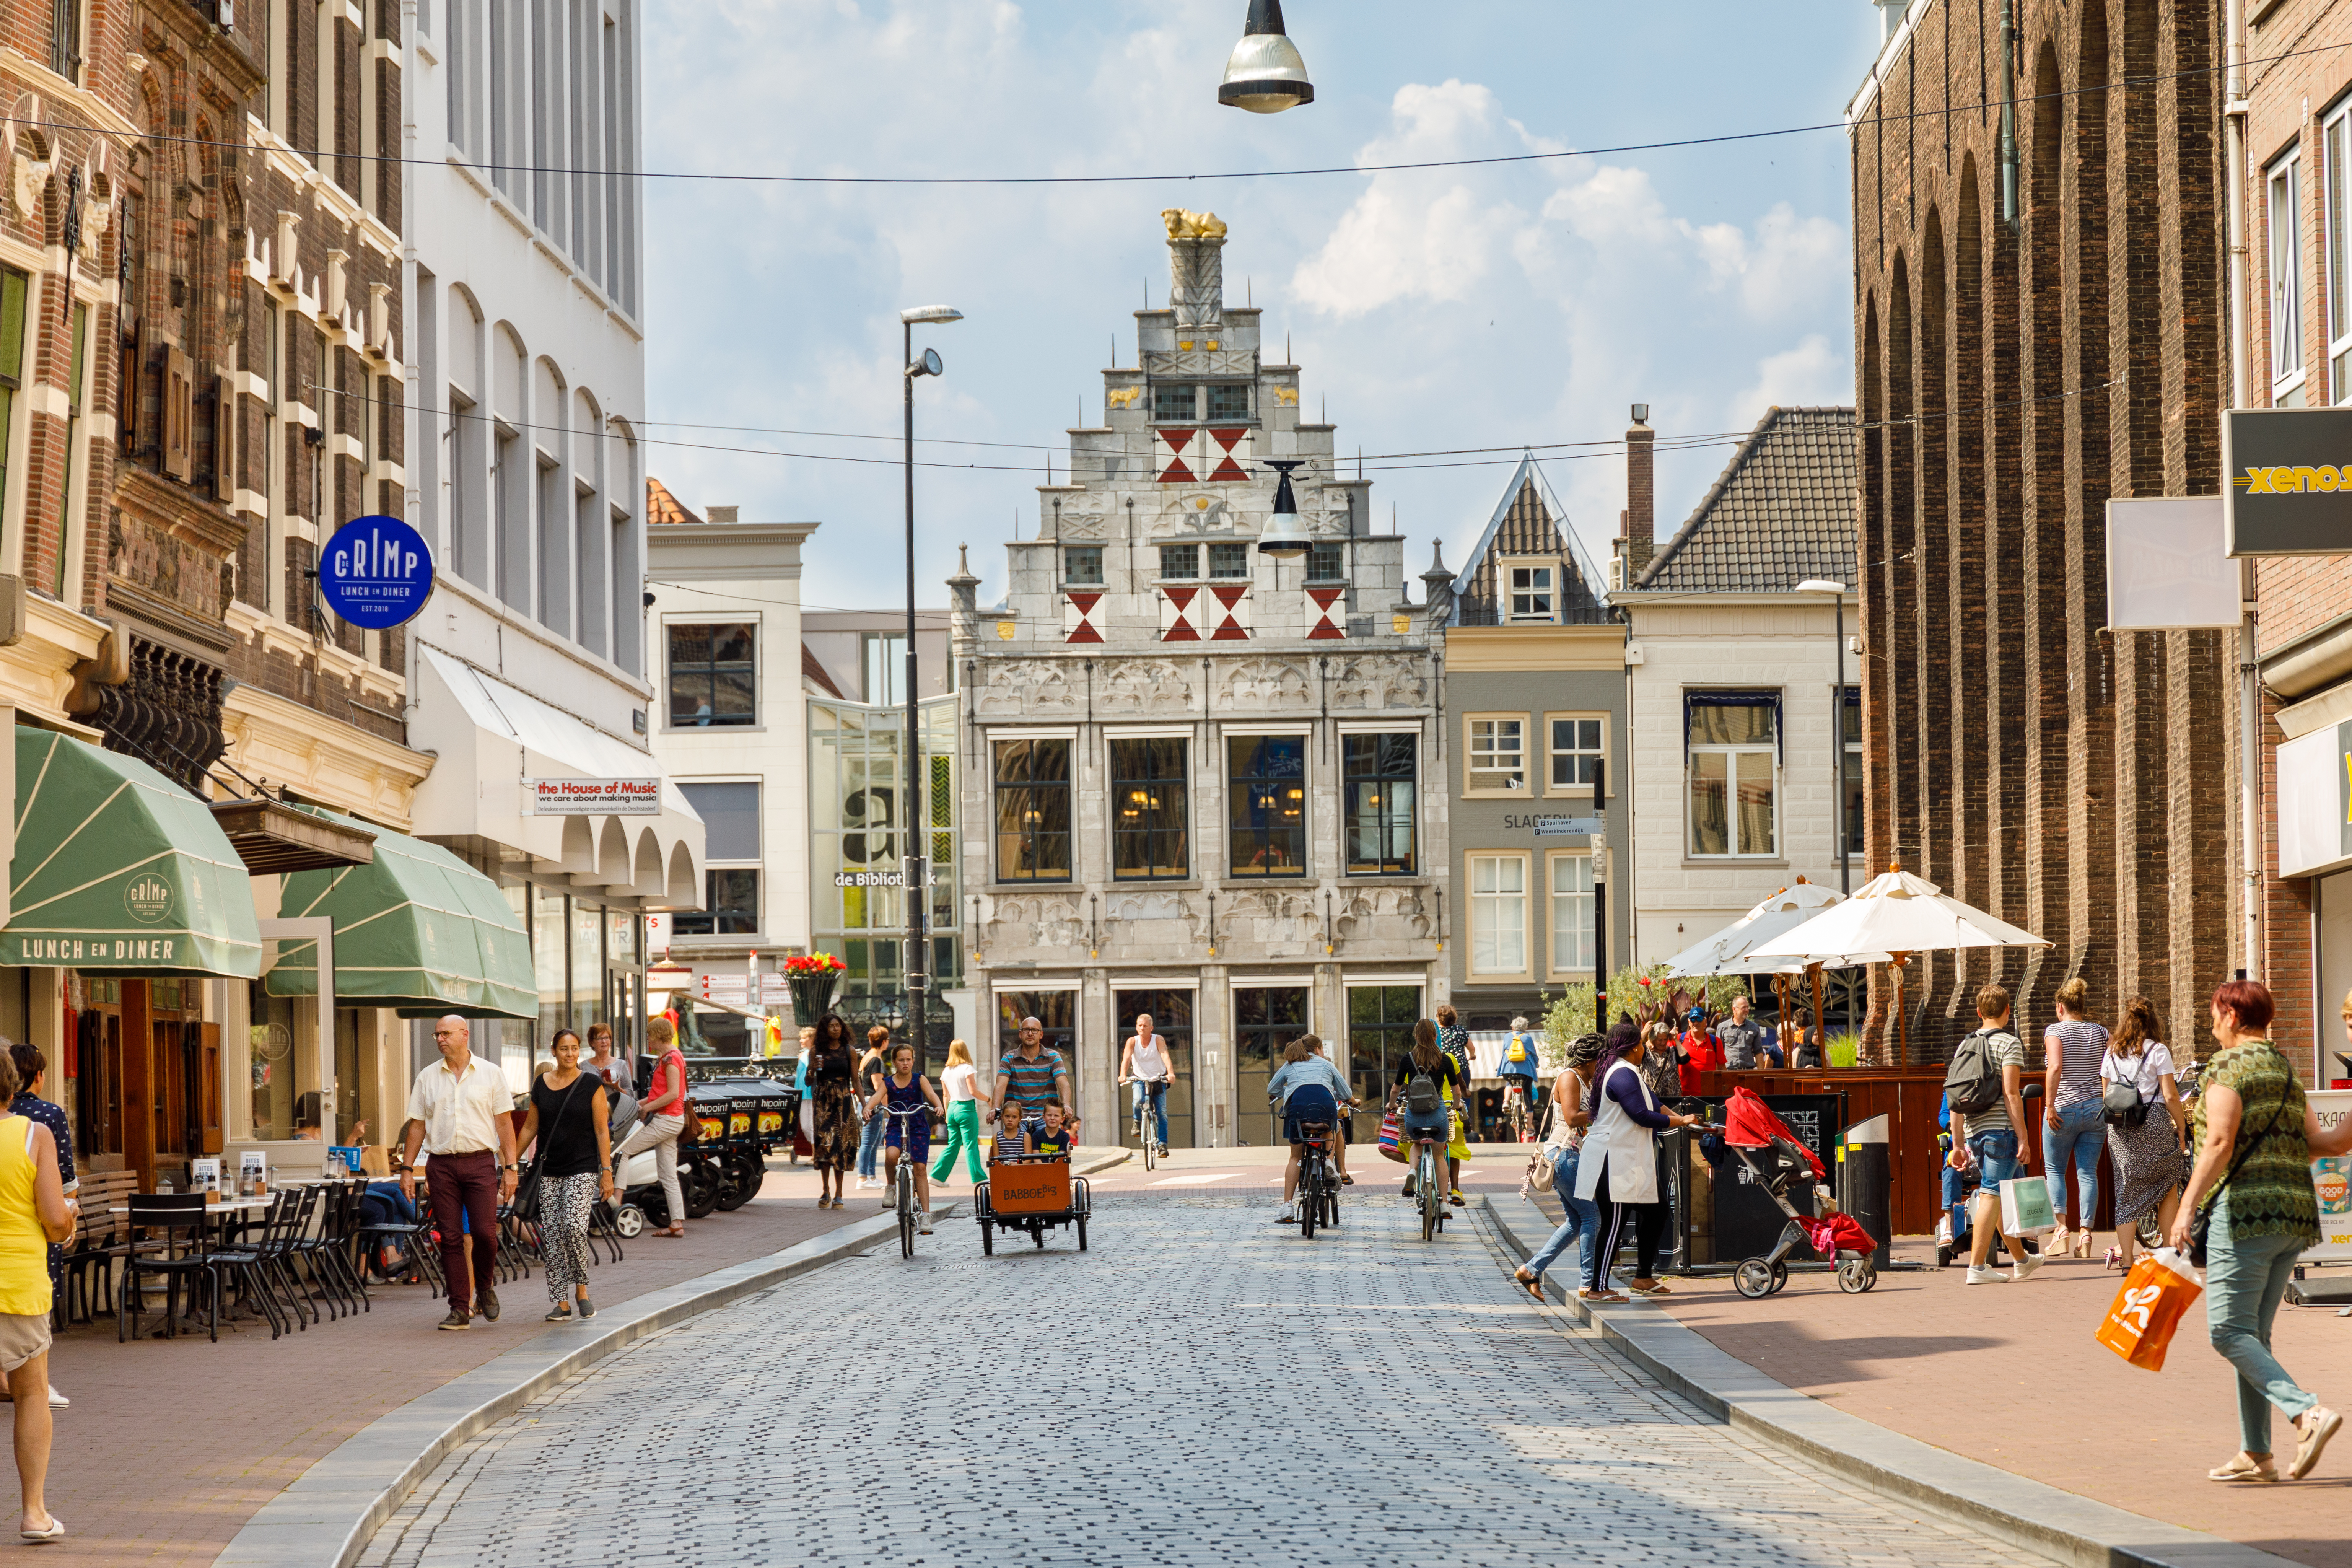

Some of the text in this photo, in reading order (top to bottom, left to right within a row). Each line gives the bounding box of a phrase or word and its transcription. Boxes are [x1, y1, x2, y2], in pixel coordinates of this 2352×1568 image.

[335, 528, 417, 578] CRIMP
[341, 586, 369, 596] LUNCH
[383, 587, 410, 596] DINER
[538, 781, 656, 794] the House of Music
[573, 794, 597, 802] about
[599, 794, 630, 803] making
[1504, 814, 1572, 828] SLAG
[835, 871, 937, 886] de Bibliotk
[131, 878, 167, 900] CRIMP
[23, 939, 173, 959] LUNCH EN DINER
[693, 1102, 728, 1115] shipoint
[2315, 1112, 2349, 1127] EKAA
[1041, 1142, 1059, 1151] SUNNY
[1004, 1184, 1057, 1200] BABBOE Big
